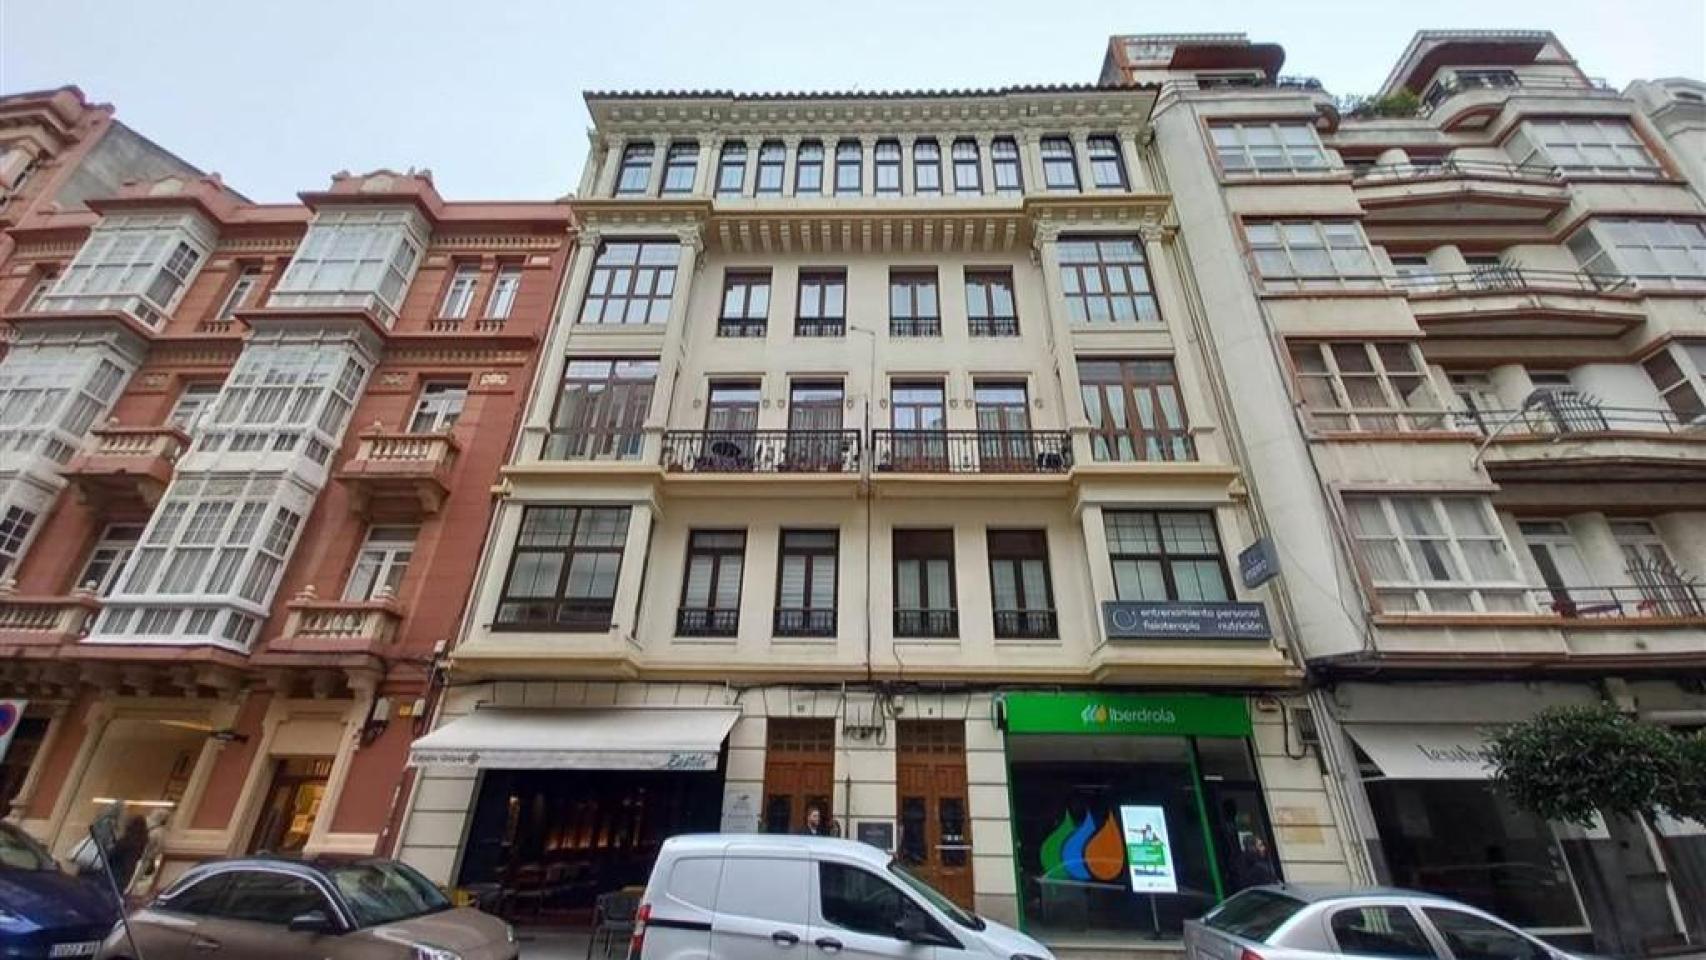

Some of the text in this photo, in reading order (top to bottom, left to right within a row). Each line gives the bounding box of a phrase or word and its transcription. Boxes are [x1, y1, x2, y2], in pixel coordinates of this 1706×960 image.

[1140, 609, 1260, 620] entrenamiento personal
[1143, 620, 1201, 632] fisioterapia
[1109, 706, 1176, 723] Iberdrola
